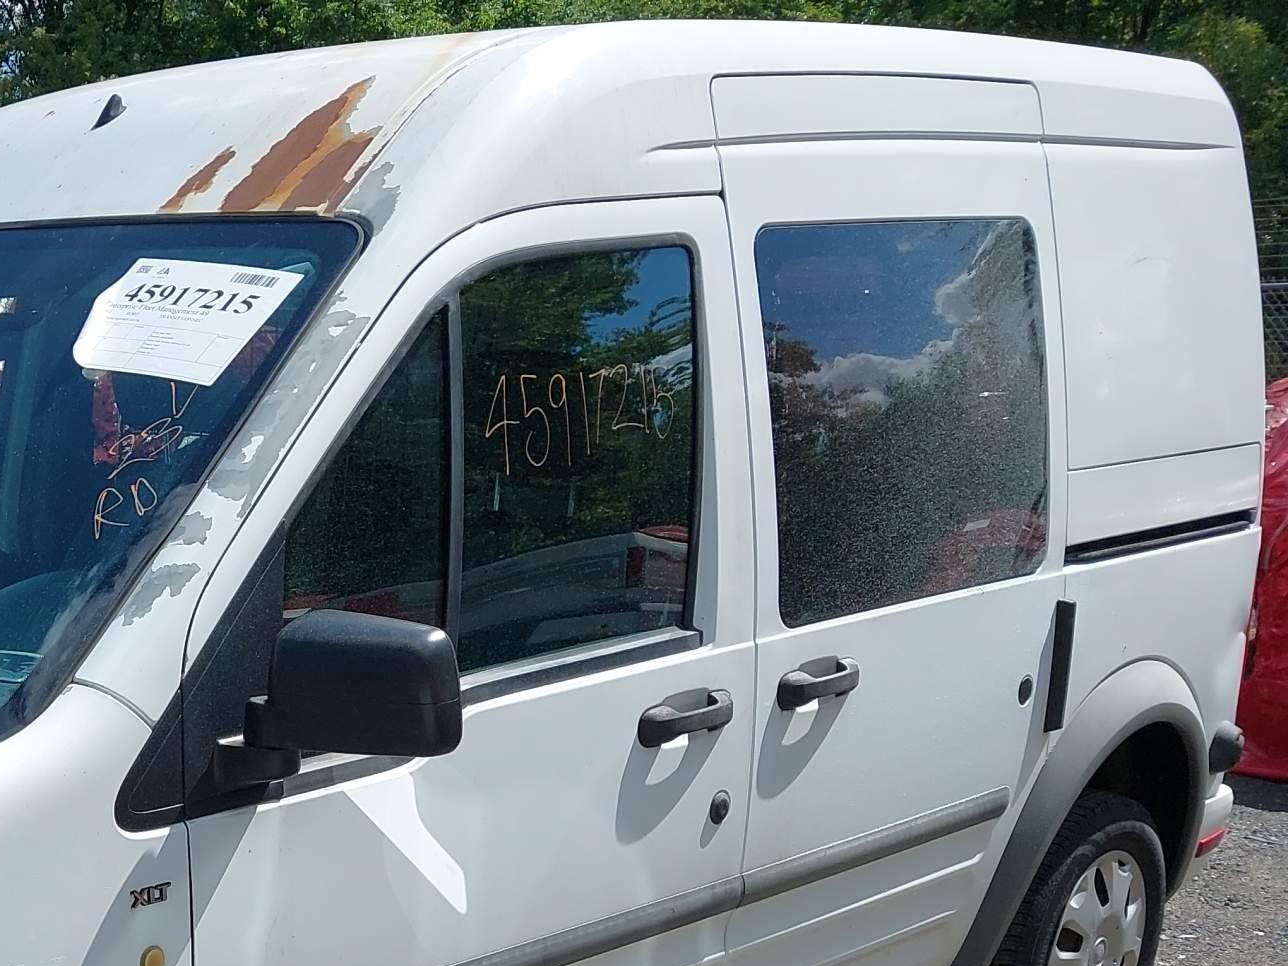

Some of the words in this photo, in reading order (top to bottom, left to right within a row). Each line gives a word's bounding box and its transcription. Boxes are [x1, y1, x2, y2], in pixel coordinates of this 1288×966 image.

[123, 282, 260, 315] 45917215
[485, 362, 675, 476] 45917215
[129, 881, 172, 910] XLT
